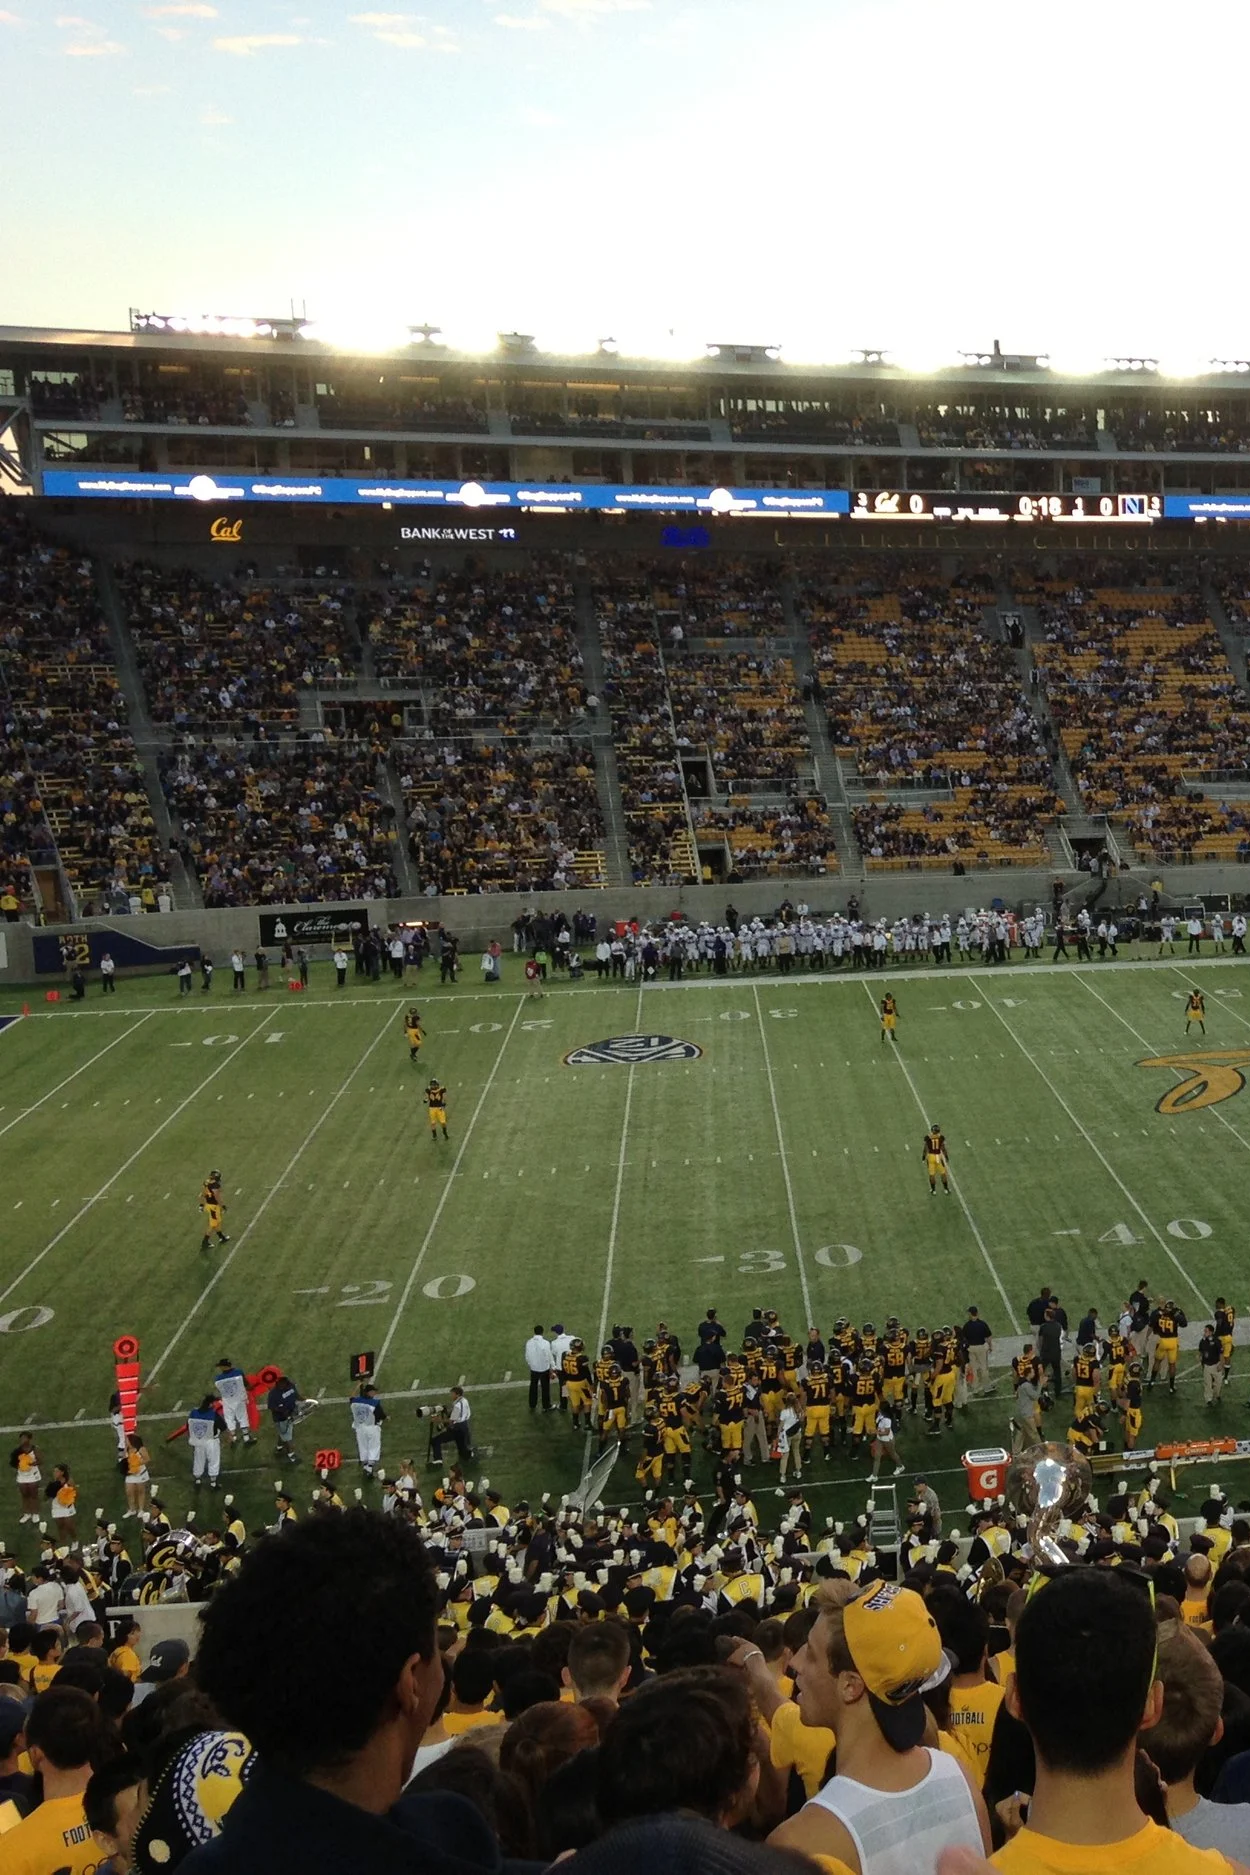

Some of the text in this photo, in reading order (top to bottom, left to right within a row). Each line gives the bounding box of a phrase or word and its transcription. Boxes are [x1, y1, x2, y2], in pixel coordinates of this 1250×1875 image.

[909, 494, 923, 514] 0
[1019, 496, 1062, 516] 0:18
[1100, 497, 1113, 516] 0
[210, 516, 243, 541] Cal
[401, 528, 441, 540] BANK
[454, 528, 495, 540] WEST
[1098, 1218, 1213, 1246] 40
[737, 1244, 863, 1274] 30
[336, 1274, 477, 1307] 20
[1158, 1319, 1174, 1332] 99
[358, 1354, 367, 1374] 1
[562, 1361, 578, 1374] 86
[785, 1354, 794, 1367] 5
[760, 1366, 776, 1379] 78
[1076, 1364, 1089, 1377] 13
[811, 1384, 826, 1398] 71
[857, 1382, 874, 1395] 66
[727, 1395, 744, 1410] 79
[316, 1452, 337, 1469] 20
[979, 1469, 998, 1490] G
[201, 1738, 245, 1779] Cal
